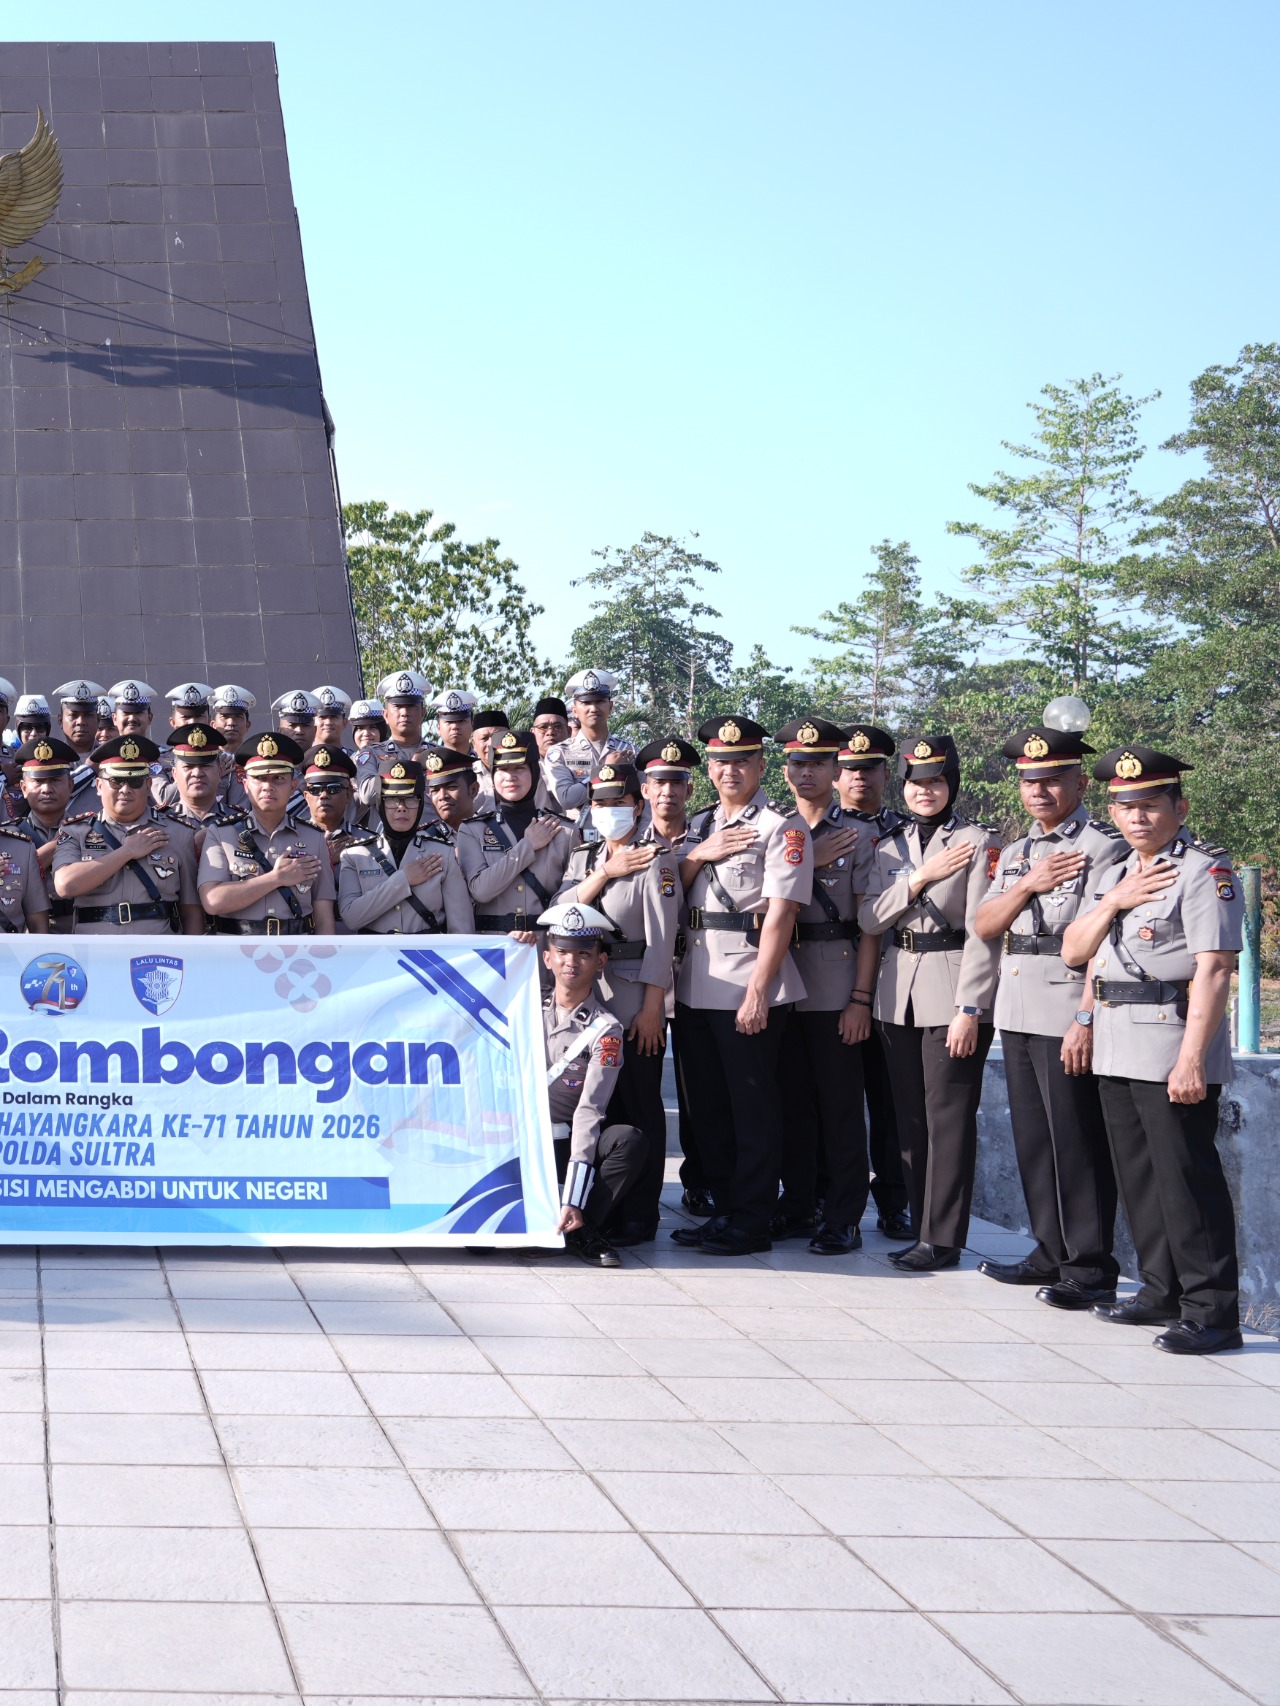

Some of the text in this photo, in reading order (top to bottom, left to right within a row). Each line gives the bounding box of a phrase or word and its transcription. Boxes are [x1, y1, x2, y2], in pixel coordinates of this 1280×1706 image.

[135, 958, 179, 966] LALU LINTAS
[70, 983, 79, 991] th
[2, 1091, 133, 1110] Dalam Rangka
[161, 1113, 227, 1138] KE-71
[235, 1114, 314, 1139] TAHUN
[321, 1114, 381, 1139] 2026
[69, 1141, 156, 1167] SULTRA
[35, 1178, 157, 1200] MENGABDI
[162, 1180, 241, 1200] UNTUK
[246, 1181, 328, 1201] NEGERI
